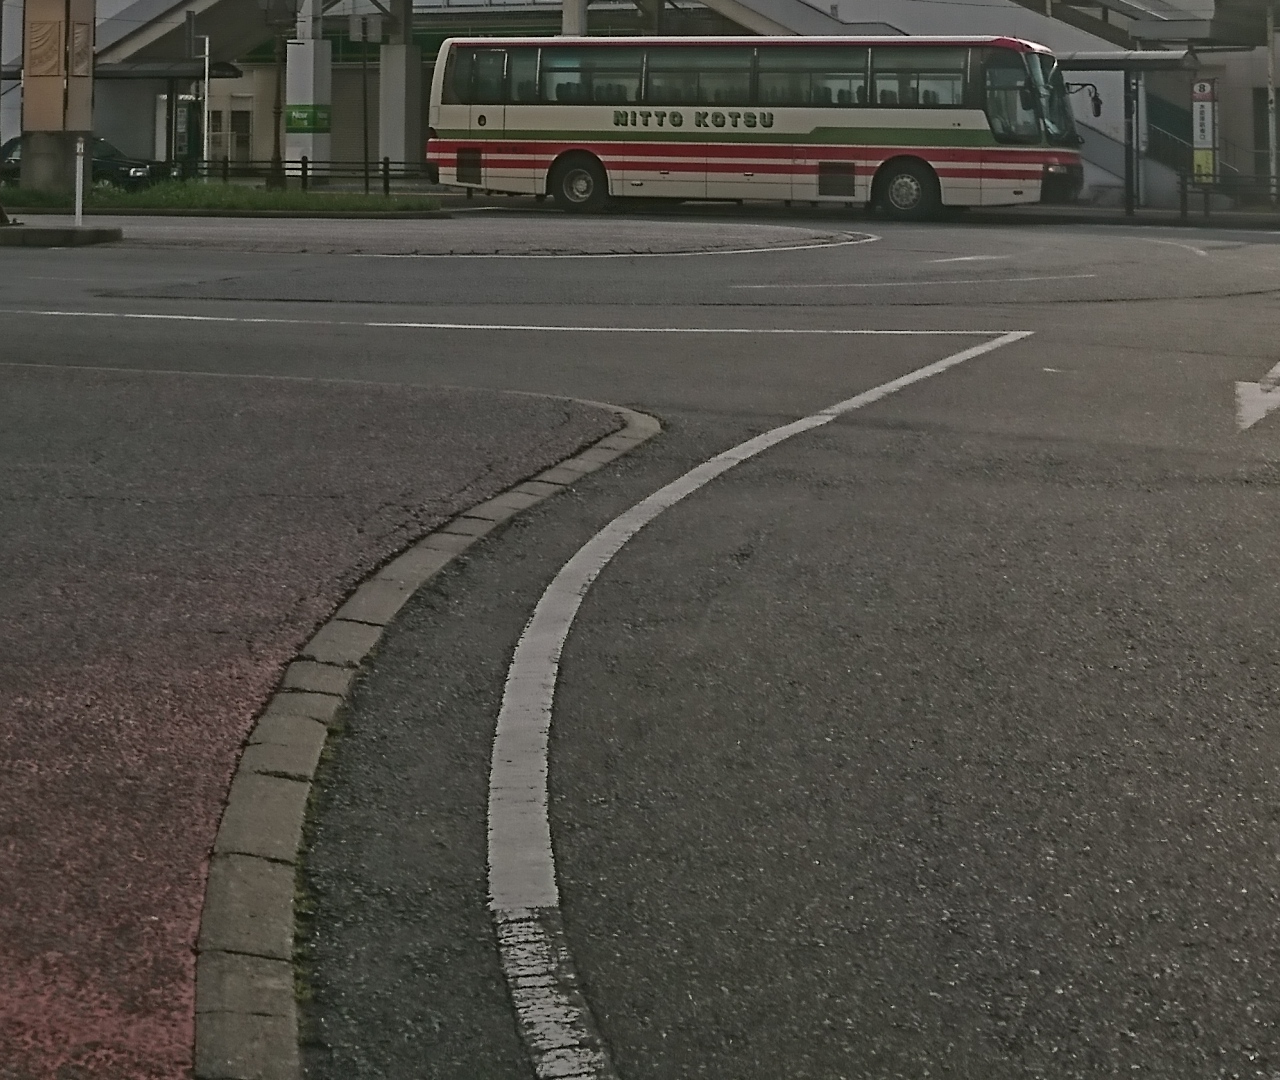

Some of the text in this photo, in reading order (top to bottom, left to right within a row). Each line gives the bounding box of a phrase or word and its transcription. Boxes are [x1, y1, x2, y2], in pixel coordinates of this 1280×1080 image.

[1198, 83, 1206, 93] 8
[613, 110, 774, 129] NITTO KOTSU
